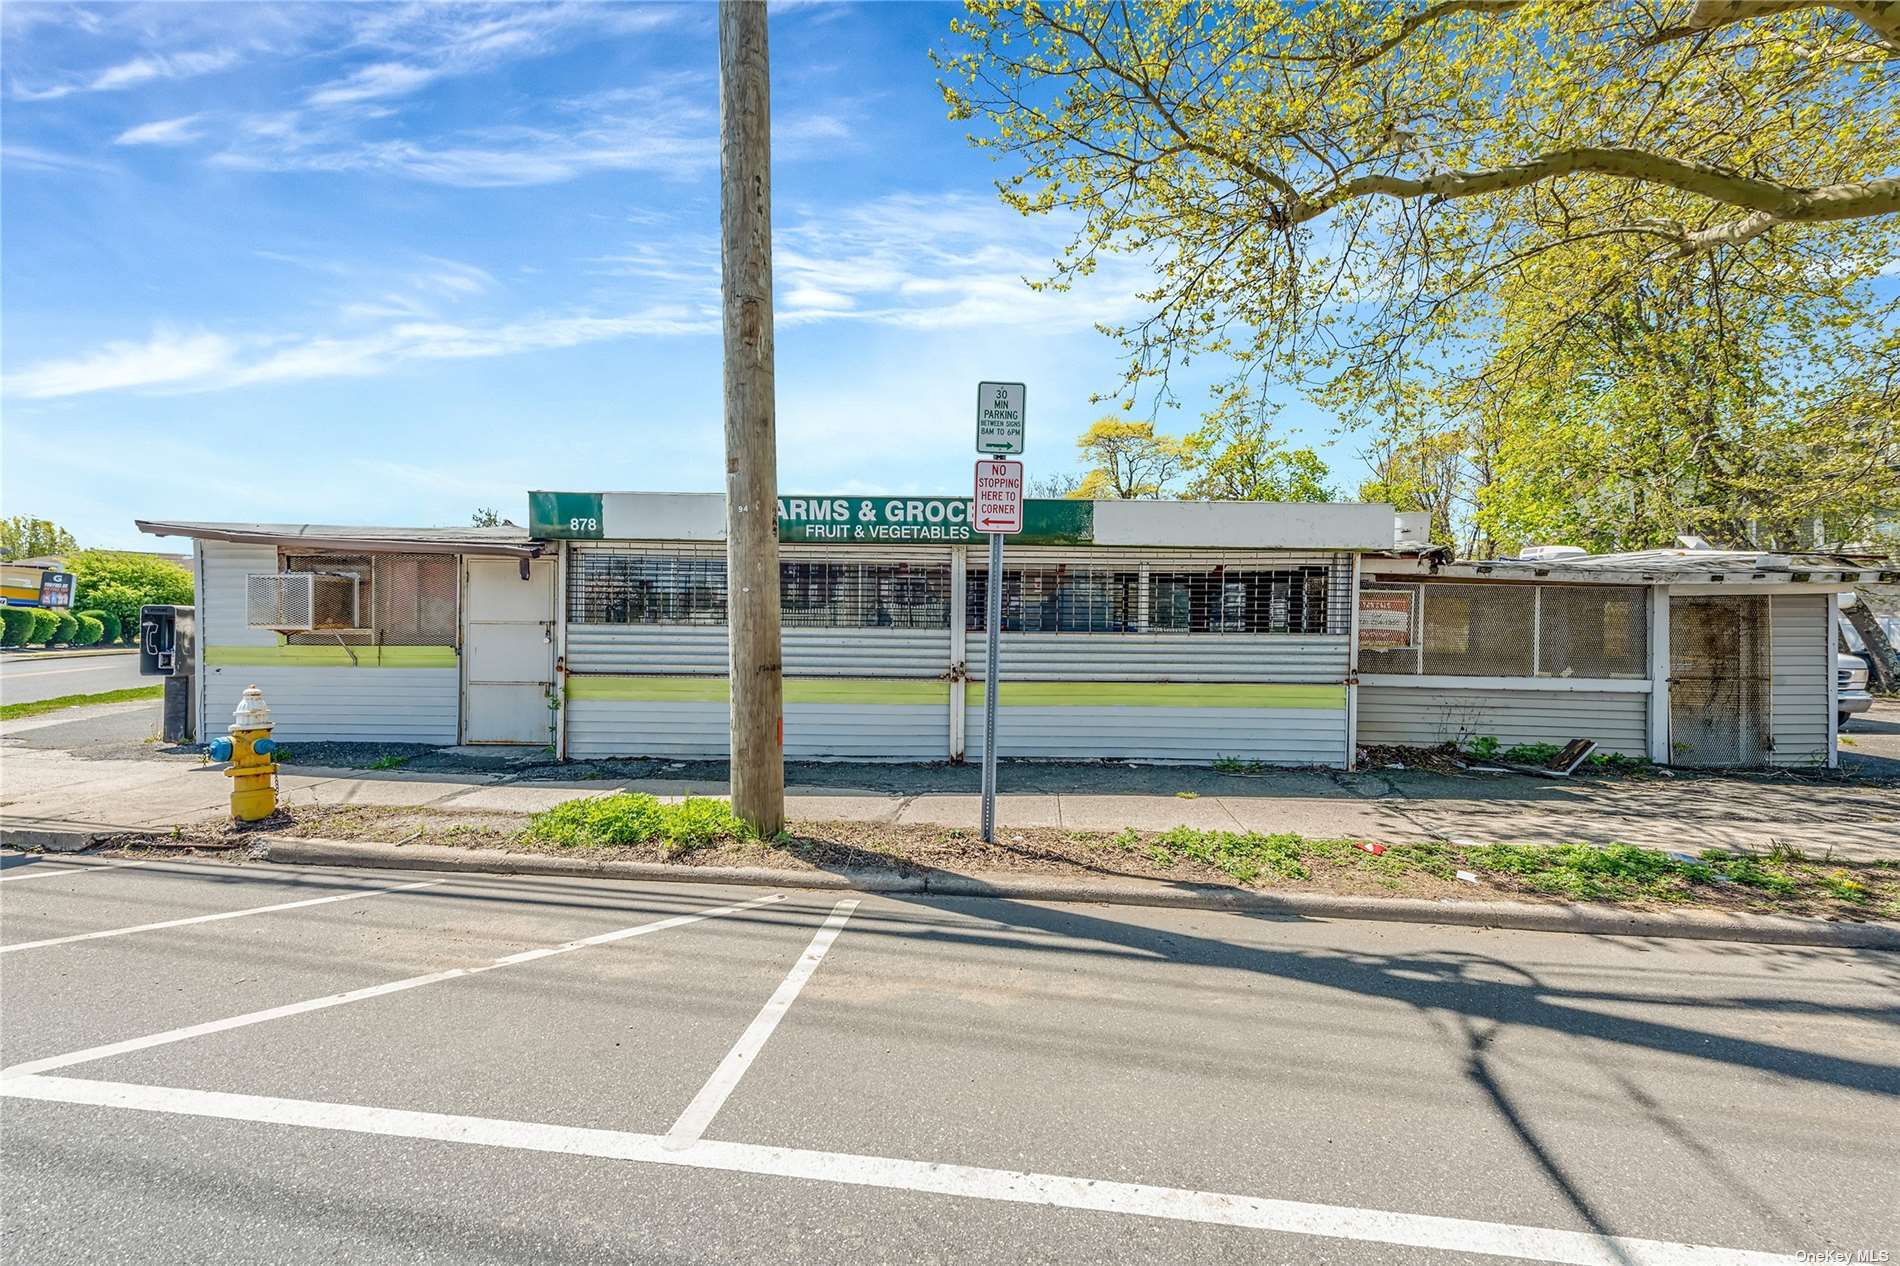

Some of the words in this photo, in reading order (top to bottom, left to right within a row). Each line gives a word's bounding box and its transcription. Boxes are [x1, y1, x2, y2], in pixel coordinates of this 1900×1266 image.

[996, 390, 1007, 398] 30
[994, 400, 1009, 409] MIN
[984, 410, 1018, 420] PARKING
[992, 465, 1007, 476] NO
[979, 478, 1019, 488] STOPPING
[981, 491, 1003, 501] HERE
[1005, 492, 1016, 501] TO
[738, 504, 749, 513] 94
[777, 500, 849, 521] ARMS
[858, 500, 876, 521] &
[981, 504, 1015, 514] CORNER
[570, 518, 597, 531] 878
[806, 524, 849, 537] FRUIT
[855, 525, 864, 537] &
[870, 525, 969, 538] VEGETABLES
